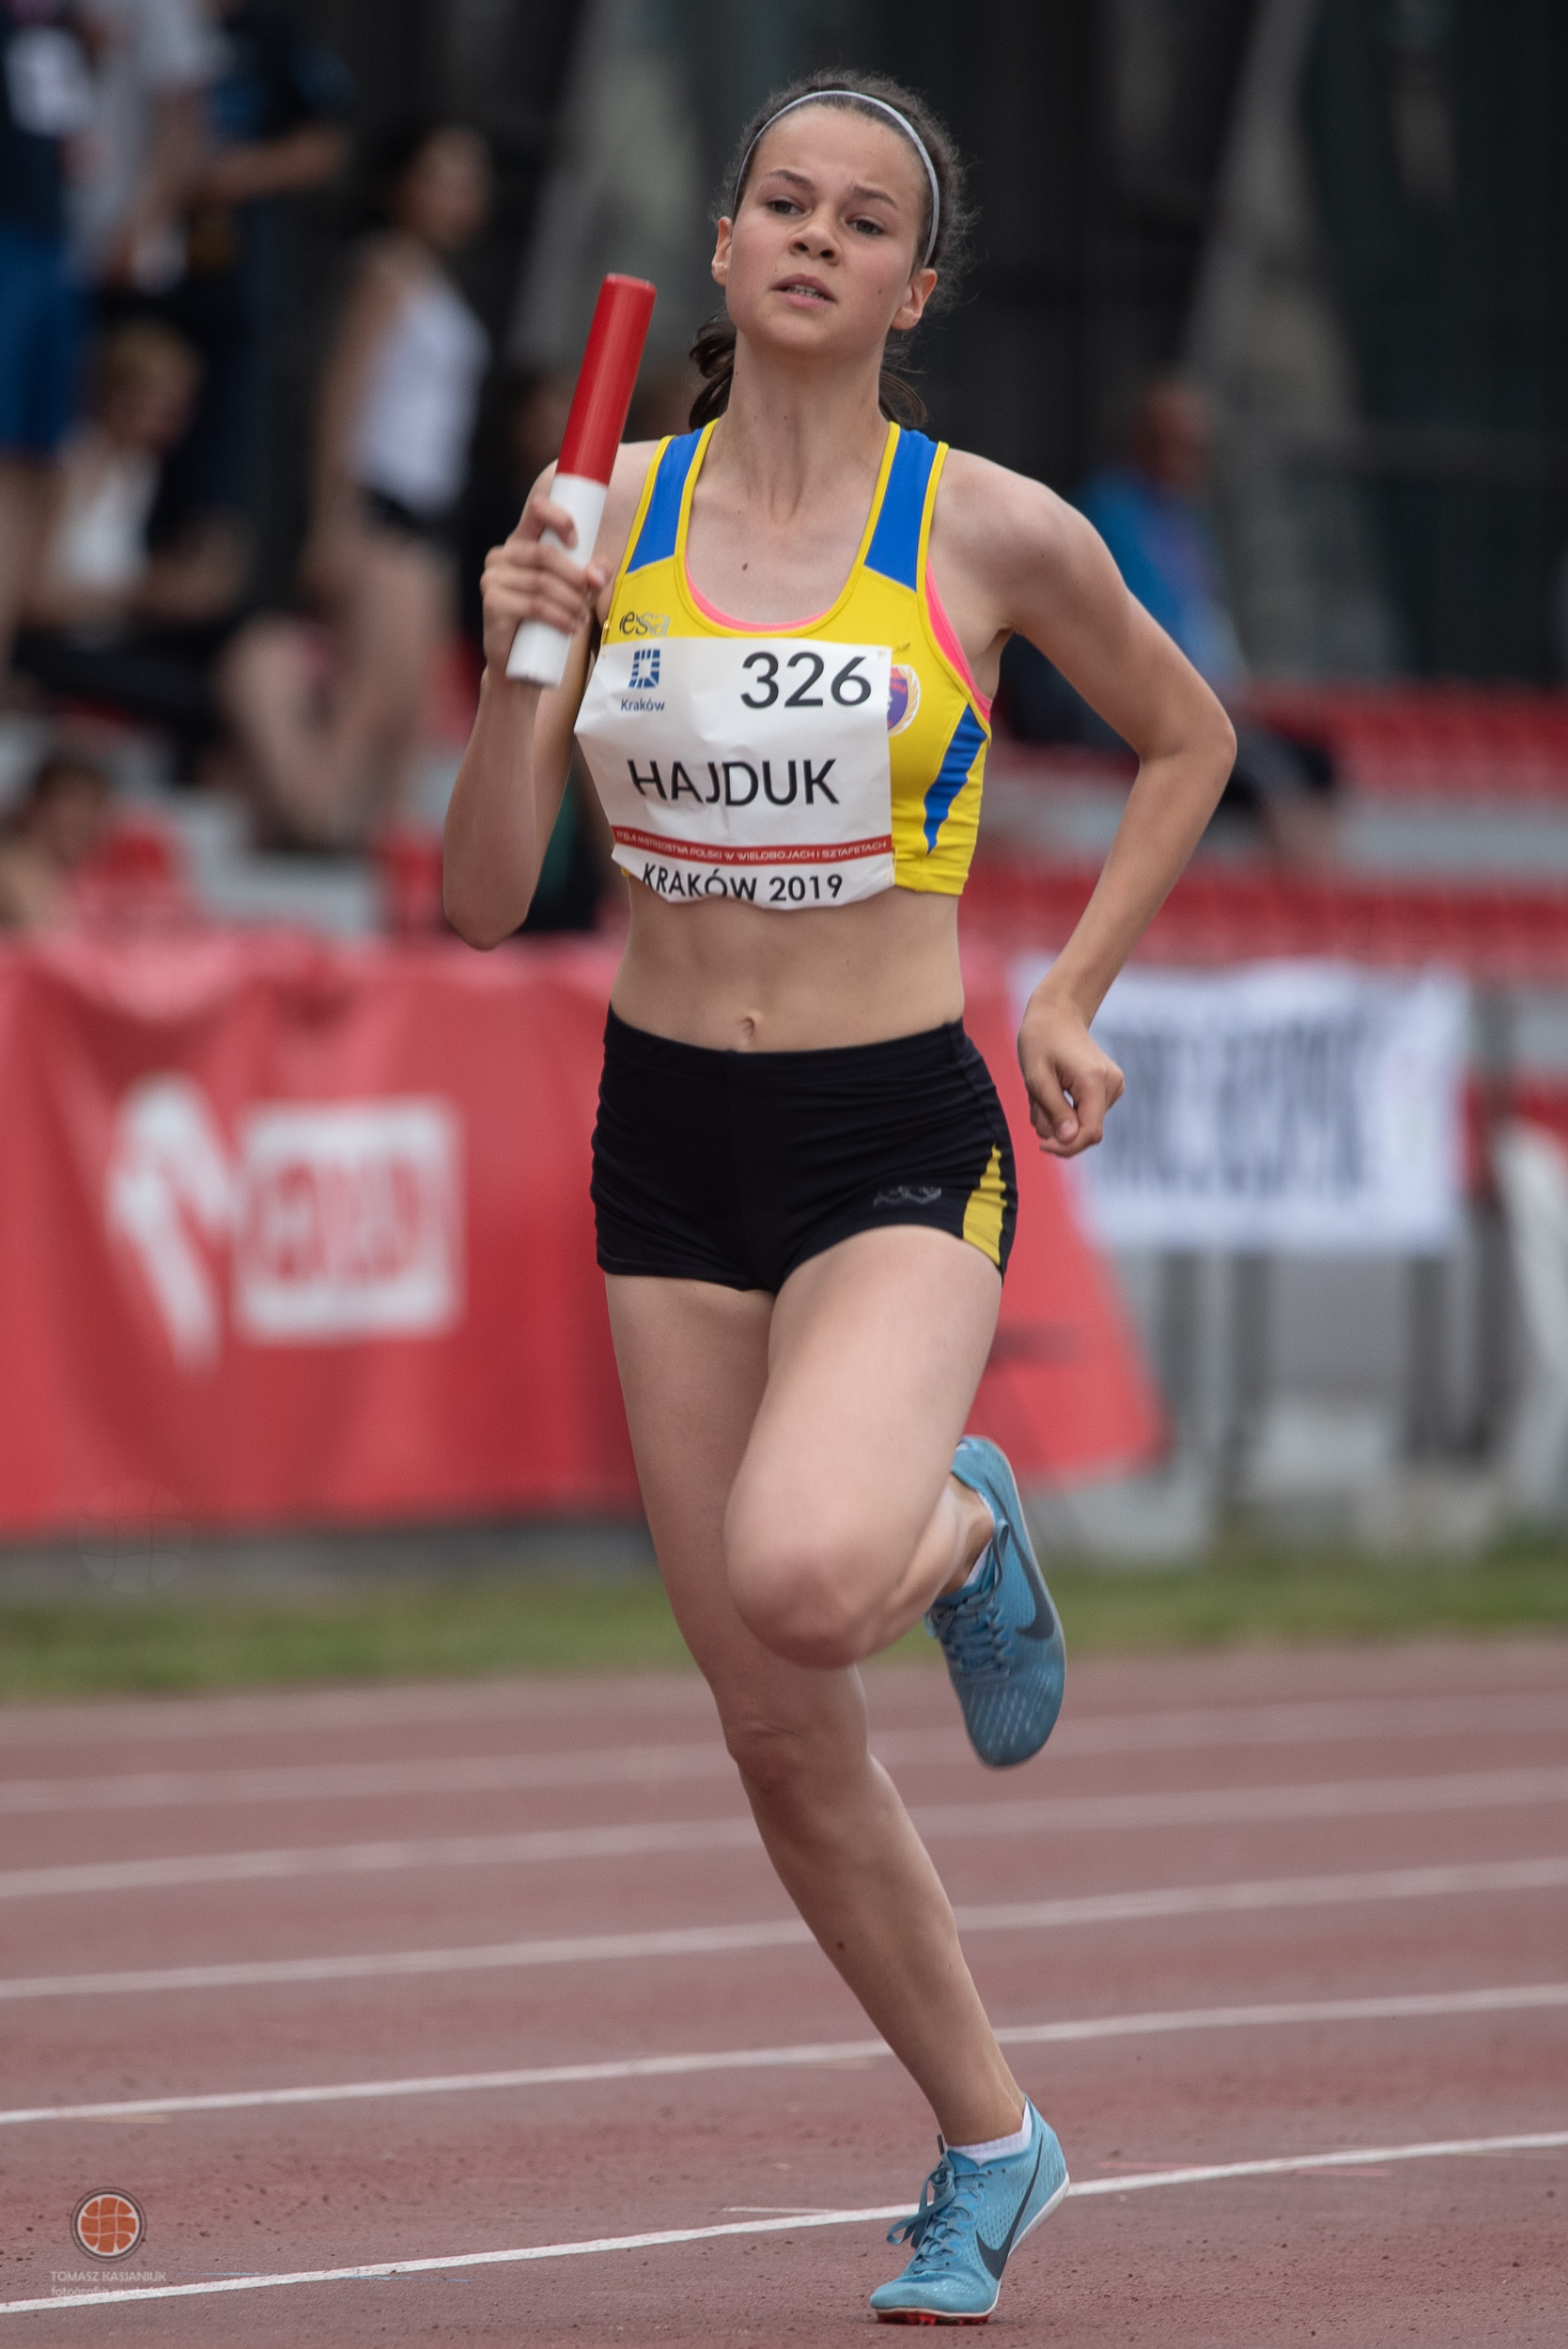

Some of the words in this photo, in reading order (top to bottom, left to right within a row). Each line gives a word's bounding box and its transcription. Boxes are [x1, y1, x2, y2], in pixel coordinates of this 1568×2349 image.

[740, 651, 872, 709] 326
[620, 697, 665, 712] Kraków
[627, 757, 840, 808] HAJDUK
[691, 848, 722, 861] POLSKI
[724, 850, 734, 861] W
[737, 849, 815, 862] WIELOBOJACH
[822, 841, 887, 860] SZTAFETACH
[643, 862, 757, 901] KRAKÓW
[769, 874, 844, 902] 2019
